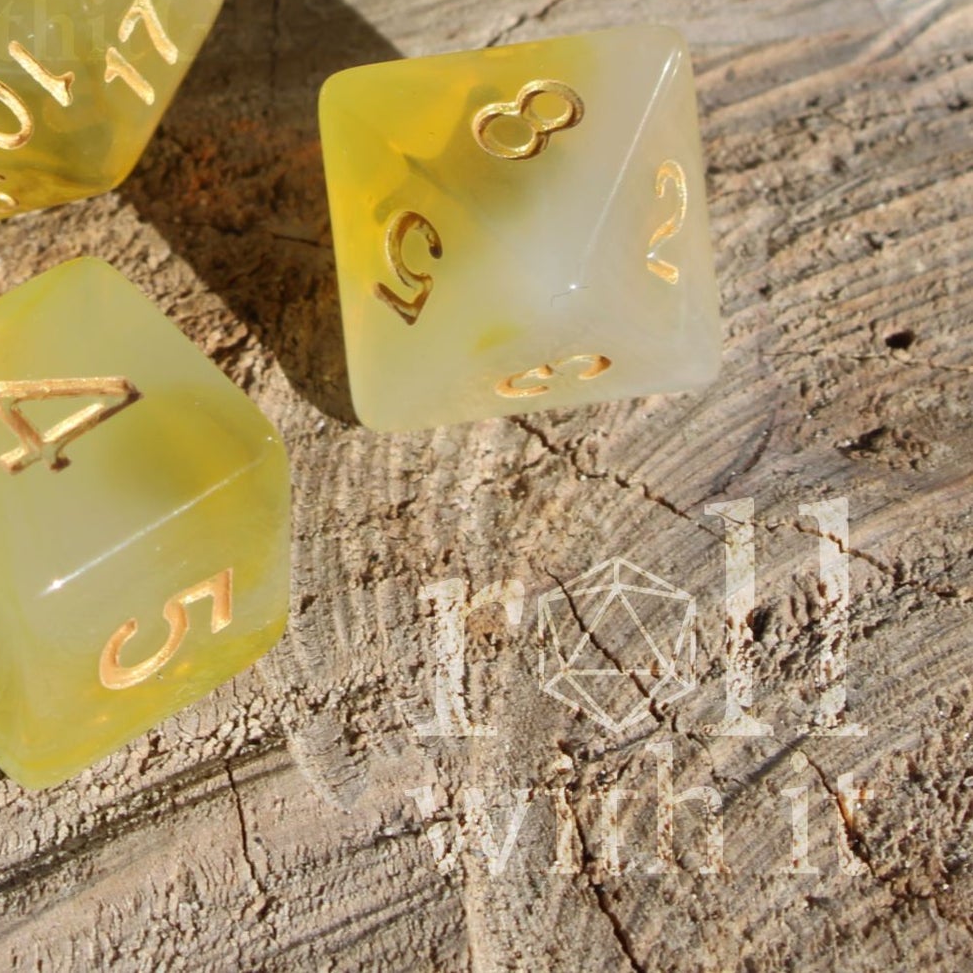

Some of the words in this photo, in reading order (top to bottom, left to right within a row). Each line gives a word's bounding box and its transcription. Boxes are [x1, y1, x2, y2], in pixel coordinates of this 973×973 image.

[471, 79, 586, 161] 8
[374, 210, 443, 327] 5
[647, 159, 688, 285] 2
[495, 353, 613, 398] 3
[98, 567, 234, 691] 5
